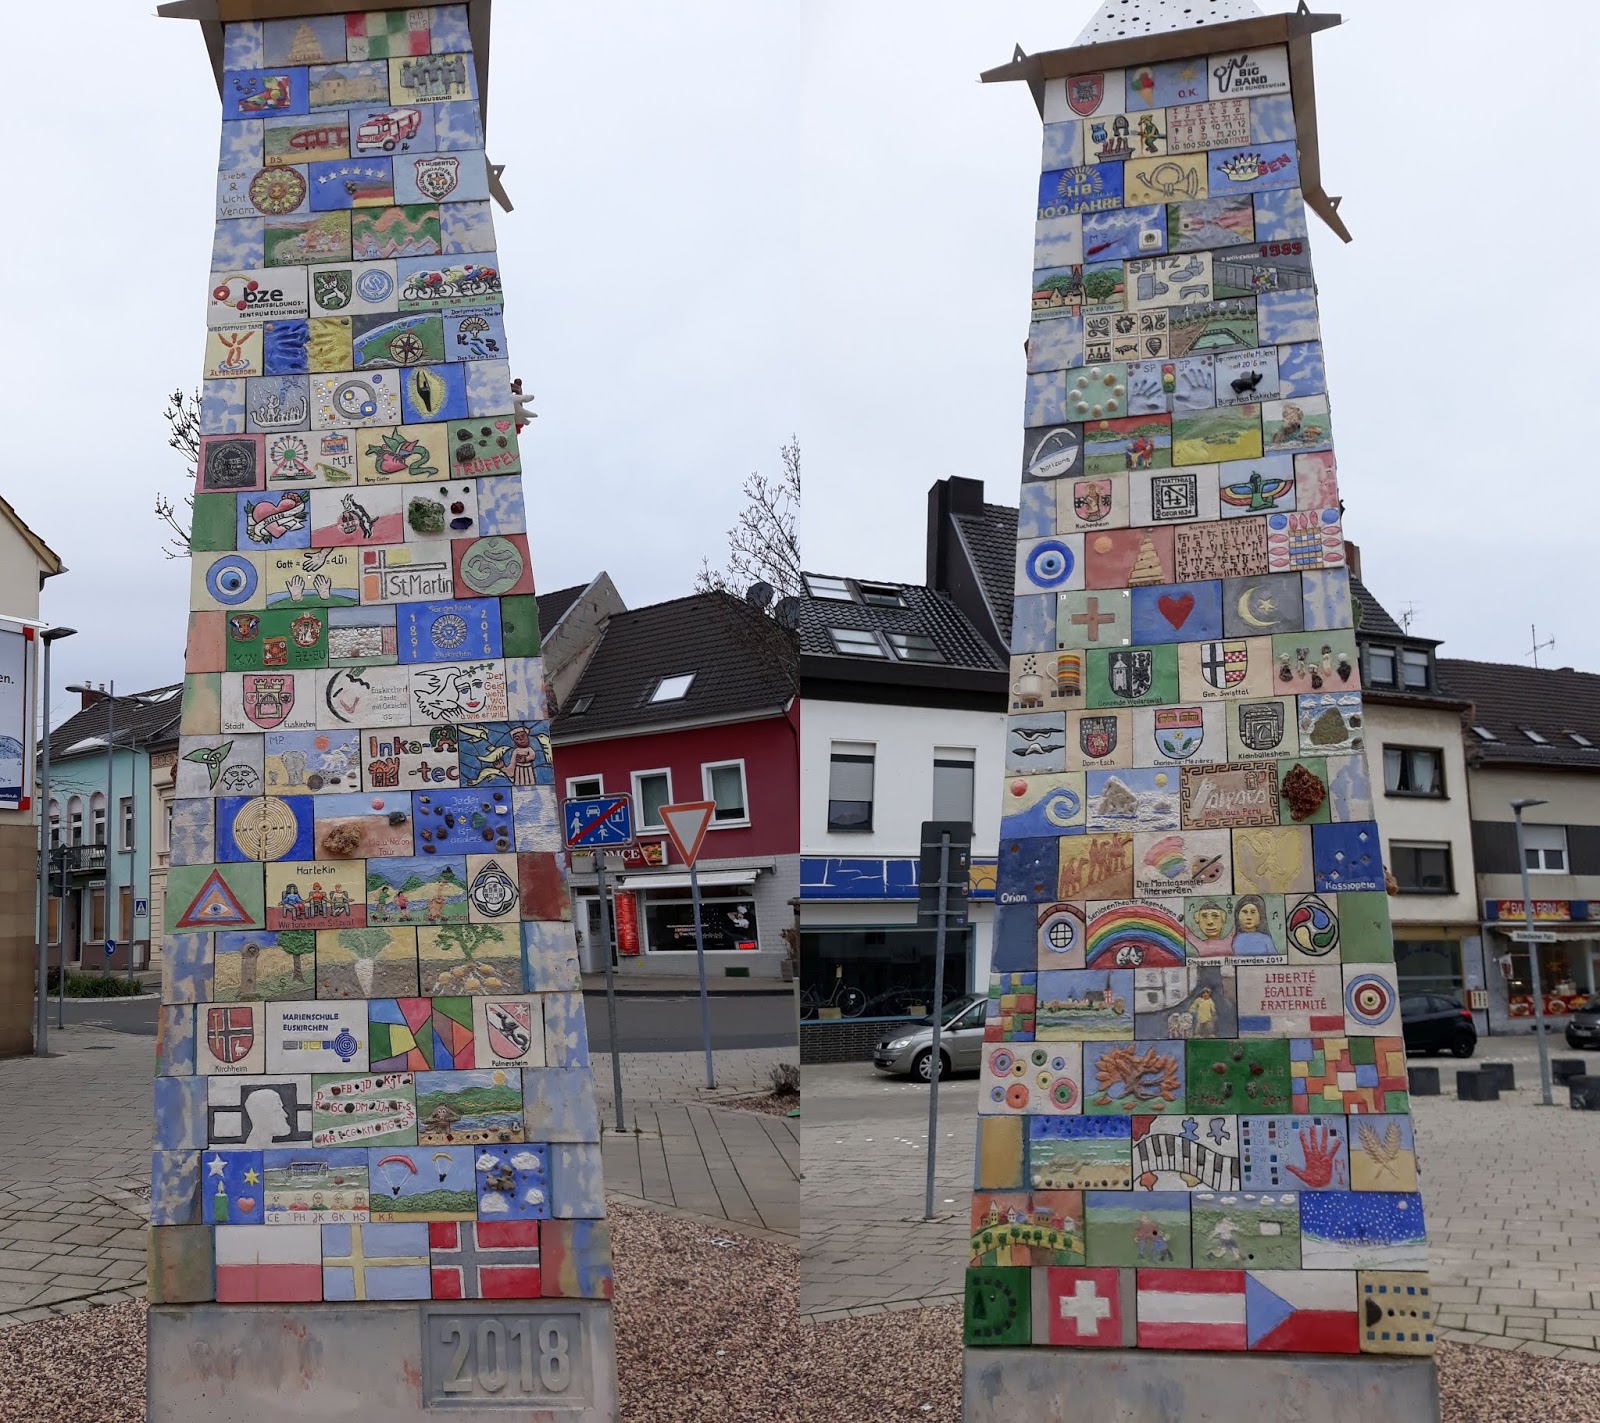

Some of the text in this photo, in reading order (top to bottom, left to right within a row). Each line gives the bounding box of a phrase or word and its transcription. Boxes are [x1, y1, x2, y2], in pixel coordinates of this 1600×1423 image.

[1238, 67, 1260, 77] BIG
[1234, 75, 1268, 87] BAND
[1245, 82, 1286, 91] BUNDESWEHR
[415, 95, 453, 103] KREUZBUND
[1257, 153, 1291, 177] BEN
[222, 194, 246, 203] Licht
[1039, 204, 1069, 220] 100
[1070, 196, 1122, 214] JAHRE
[1226, 253, 1260, 262] NOVEMBER
[1260, 242, 1303, 258] 1989
[1129, 256, 1181, 275] SPITZ
[243, 287, 284, 303] bze
[247, 301, 305, 309] BERUFSBILDUNGS-
[239, 310, 270, 318] ZENTRUM
[208, 324, 248, 333] MEDITATIVER
[457, 334, 499, 352] K R
[452, 450, 519, 477] TRÜFFEL
[1040, 456, 1071, 473] horizons
[1076, 520, 1110, 530] Kuchenheim
[276, 559, 294, 569] Gott
[486, 672, 503, 680] Der
[484, 681, 505, 690] Geist
[1219, 688, 1249, 697] Swisttal
[1098, 696, 1162, 707] Gemeinde Weilerswist
[224, 720, 316, 730] Stadt Euskirchen
[1238, 750, 1291, 760] Kleinbüllesheim
[1242, 807, 1262, 815] Peru
[378, 847, 395, 856] Tour
[1136, 880, 1149, 888] Die
[1000, 892, 1028, 903] Orion
[1141, 898, 1178, 919] Regenbogen
[278, 920, 291, 928] Wir
[1264, 970, 1316, 984] LIBERTÉ
[1264, 984, 1313, 998] ÉGALITÉ
[1260, 998, 1327, 1011] FRATERNITÉ
[282, 1013, 339, 1021] MARIENSCHULE
[282, 1024, 328, 1032] EUSKIRCHEN
[214, 1064, 248, 1072] Kirchheim
[267, 1213, 280, 1222] CE
[353, 1212, 366, 1222] HS
[441, 1319, 571, 1393] 2018
